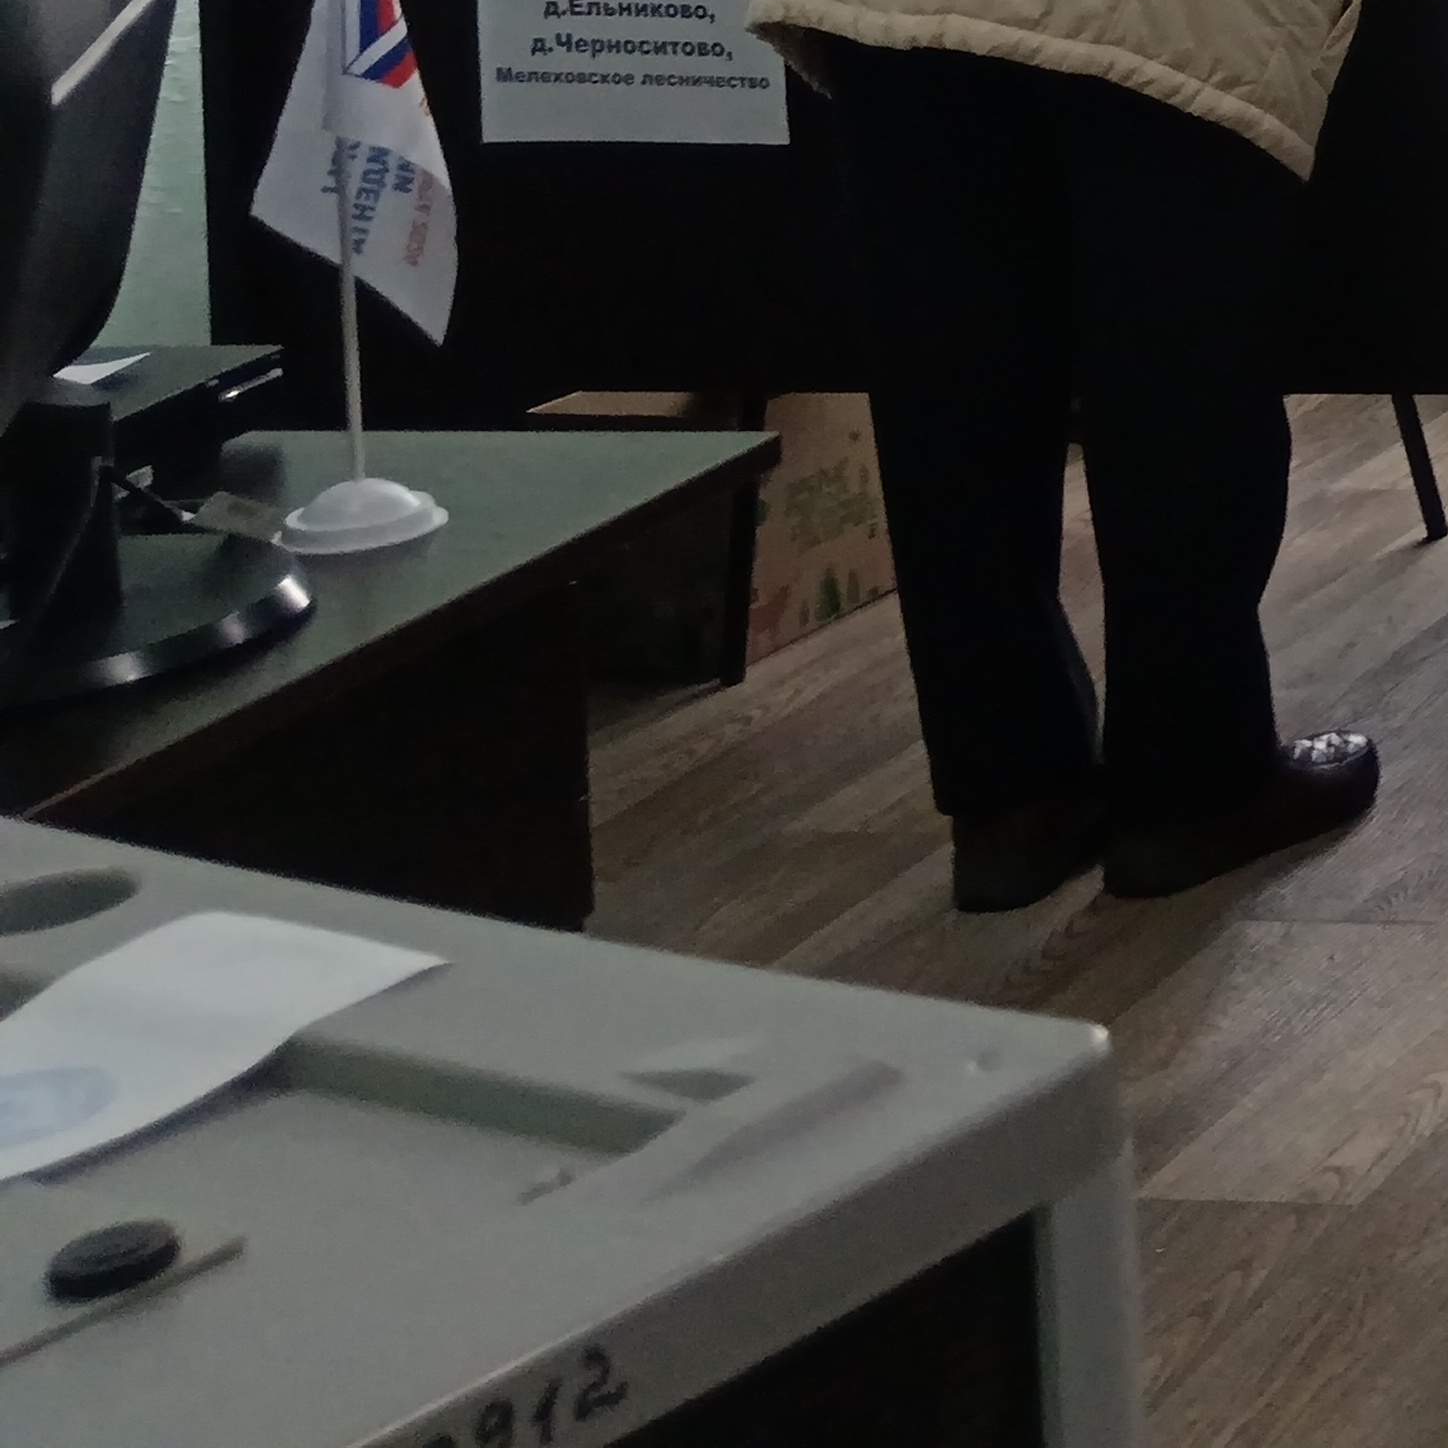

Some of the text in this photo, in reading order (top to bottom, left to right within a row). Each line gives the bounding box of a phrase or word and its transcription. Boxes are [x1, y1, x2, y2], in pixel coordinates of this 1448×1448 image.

[531, 32, 734, 61] д.Черноситово,
[641, 71, 771, 90] лесничество
[420, 1342, 629, 1448] 912
